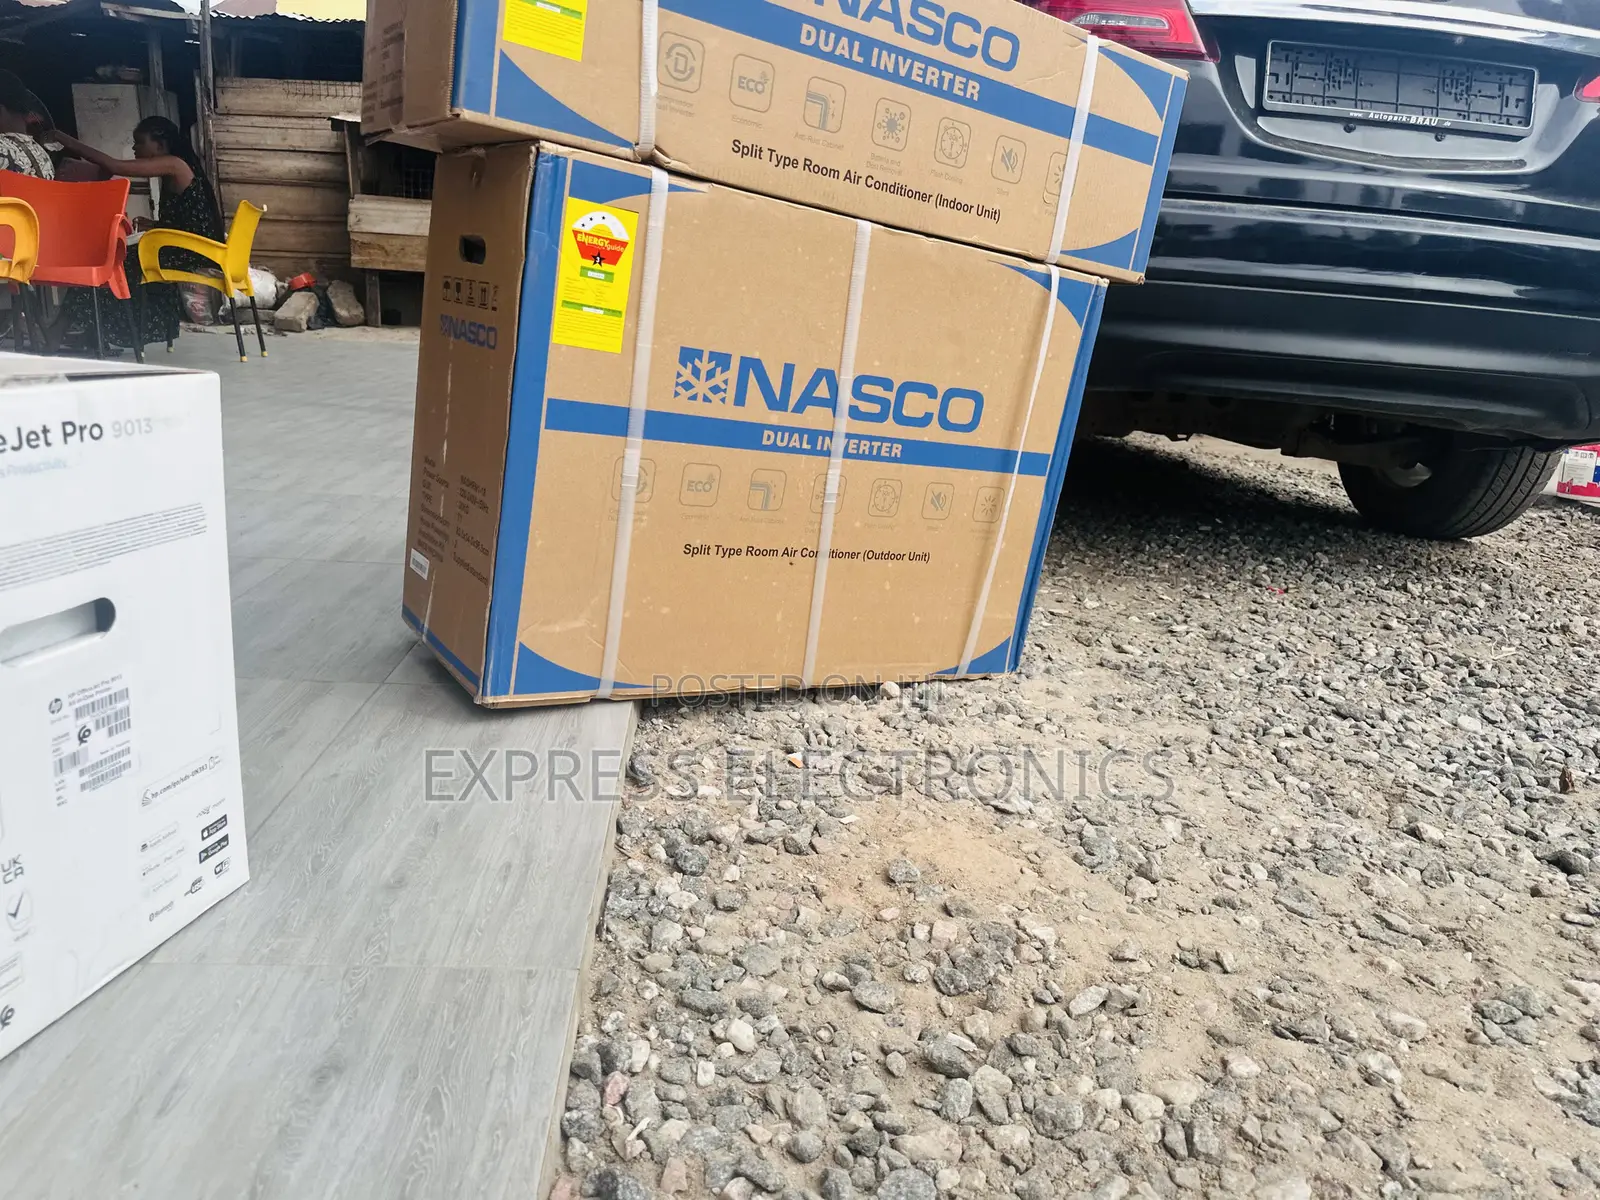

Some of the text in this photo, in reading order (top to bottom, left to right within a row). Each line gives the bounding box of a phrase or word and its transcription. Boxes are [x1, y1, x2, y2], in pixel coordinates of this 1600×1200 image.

[813, 0, 1020, 72] ASCO
[800, 23, 981, 101] DUAL INVERTER
[737, 75, 765, 95] ECO
[732, 138, 1001, 224] Split Type Room Air Conditioner (Indoor Unit)
[577, 232, 610, 248] ENERGY
[450, 315, 498, 350] NASCO
[733, 355, 985, 433] NASCO
[61, 420, 104, 445] Pro
[111, 418, 153, 439] 9013
[762, 429, 811, 449] DUAL
[687, 480, 712, 493] ECO
[683, 543, 930, 564] Split Type Room Air Conitioner (Outdoor Unit)
[1, 853, 22, 873] UK
[3, 866, 24, 884] CA
